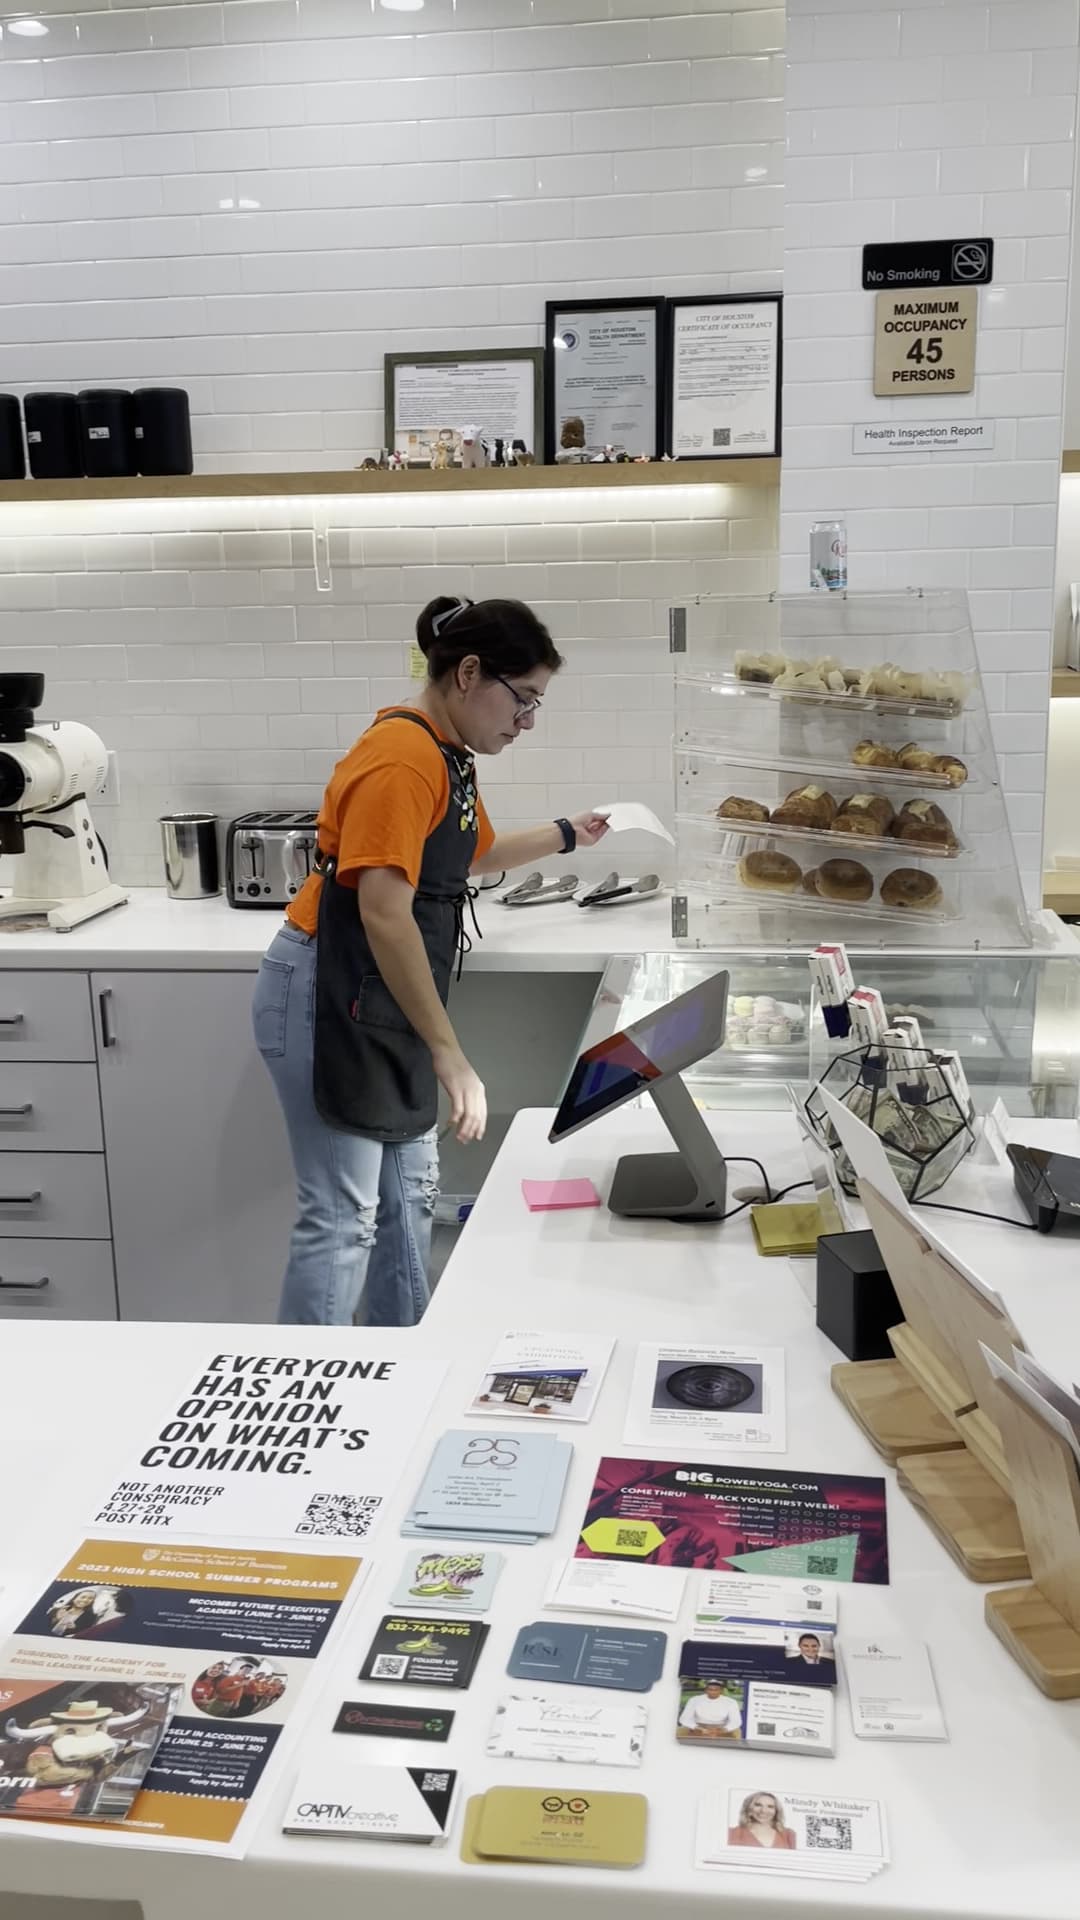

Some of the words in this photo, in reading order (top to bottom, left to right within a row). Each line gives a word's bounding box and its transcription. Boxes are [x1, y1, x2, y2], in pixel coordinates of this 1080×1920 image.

[866, 270, 884, 282] No
[887, 268, 941, 281] Smoking
[894, 302, 959, 316] MAXIMUM
[696, 314, 710, 322] CITY
[678, 324, 720, 332] CERTIFICATE
[884, 318, 968, 333] OCCUPANCY
[906, 337, 943, 364] 45
[892, 368, 955, 382] PERSONS
[864, 429, 895, 440] Health
[898, 428, 949, 438] Inspection
[951, 426, 984, 437] Report
[208, 1354, 396, 1380] EVERYONE
[192, 1376, 272, 1398] HAS
[280, 1381, 336, 1400] AN
[176, 1399, 342, 1424] OPINION
[158, 1422, 217, 1443] ON
[226, 1424, 370, 1450] WHAT'S
[140, 1446, 312, 1475] COMING.
[675, 1470, 714, 1483] BIG
[716, 1477, 818, 1492] POWERYOGA.COM
[117, 1482, 149, 1492] NOT
[152, 1484, 225, 1496] ANOTHER
[620, 1487, 652, 1495] COME
[654, 1490, 687, 1498] THRU!
[110, 1492, 212, 1506] CONSPIRACY
[704, 1493, 739, 1502] TRACK
[740, 1497, 772, 1505] YOUR
[773, 1500, 802, 1508] FIRST
[804, 1502, 840, 1510] WEEK!
[95, 1512, 138, 1524] POST
[141, 1515, 173, 1526] HTX
[78, 1564, 110, 1572] 2023
[112, 1566, 145, 1575] HIGH
[148, 1569, 201, 1579] SCHOOL
[205, 1573, 262, 1584] SUMMER
[264, 1578, 339, 1589] PROGRAMS
[188, 1598, 238, 1607] MCCOMBS
[239, 1601, 276, 1611] FUTURE
[277, 1604, 331, 1614] EXECUTIVE
[196, 1607, 243, 1617] ACADEMY
[244, 1610, 273, 1619] (JUNE
[288, 1613, 314, 1621] JUNE
[385, 1622, 472, 1635] 832-744-9492
[73, 1654, 91, 1662] THE
[412, 1656, 444, 1664] FOLLOW
[166, 1728, 192, 1736] SELF
[205, 1732, 268, 1743] ACCOUNTING
[172, 1738, 200, 1746] (JUNE
[220, 1743, 246, 1751] JUNE
[784, 1796, 819, 1808] Mindy
